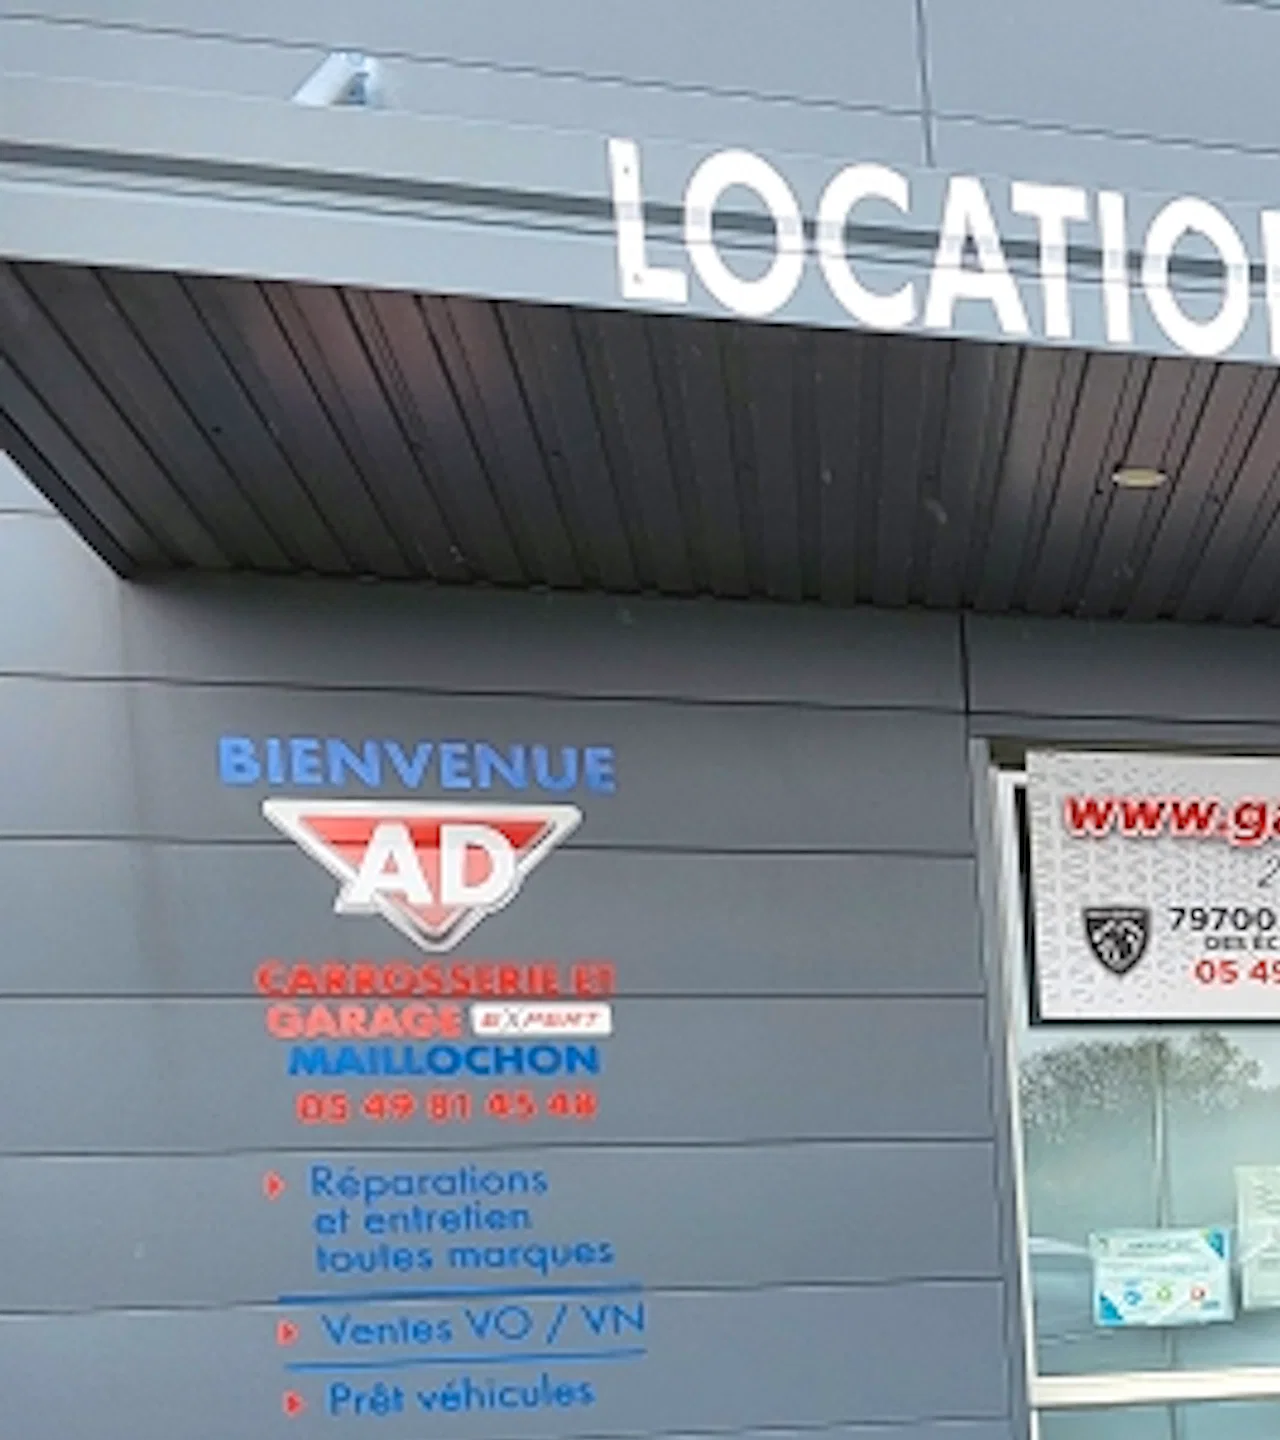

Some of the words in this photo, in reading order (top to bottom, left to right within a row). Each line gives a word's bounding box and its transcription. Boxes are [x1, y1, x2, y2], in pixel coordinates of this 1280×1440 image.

[218, 736, 617, 792] BIENVENUE
[335, 820, 519, 913] AD
[1257, 858, 1280, 890] 2
[1168, 907, 1277, 930] 79700
[255, 960, 560, 997] CARROSSERIE
[1195, 959, 1238, 984] 05
[266, 1004, 463, 1039] GARAGE
[287, 1043, 602, 1076] MAILLOCHON
[296, 1091, 349, 1124] 05
[361, 1090, 414, 1122] 49
[425, 1089, 471, 1122] 81
[310, 1165, 549, 1204] Réparations
[313, 1207, 348, 1235] et
[363, 1201, 532, 1234] entretien
[316, 1243, 433, 1273] toutes
[448, 1239, 616, 1276] marques
[320, 1311, 453, 1346] Ventes
[465, 1305, 533, 1341] VO
[581, 1302, 645, 1337] VN
[329, 1380, 405, 1417] Prêt
[416, 1372, 596, 1411] véhicules
